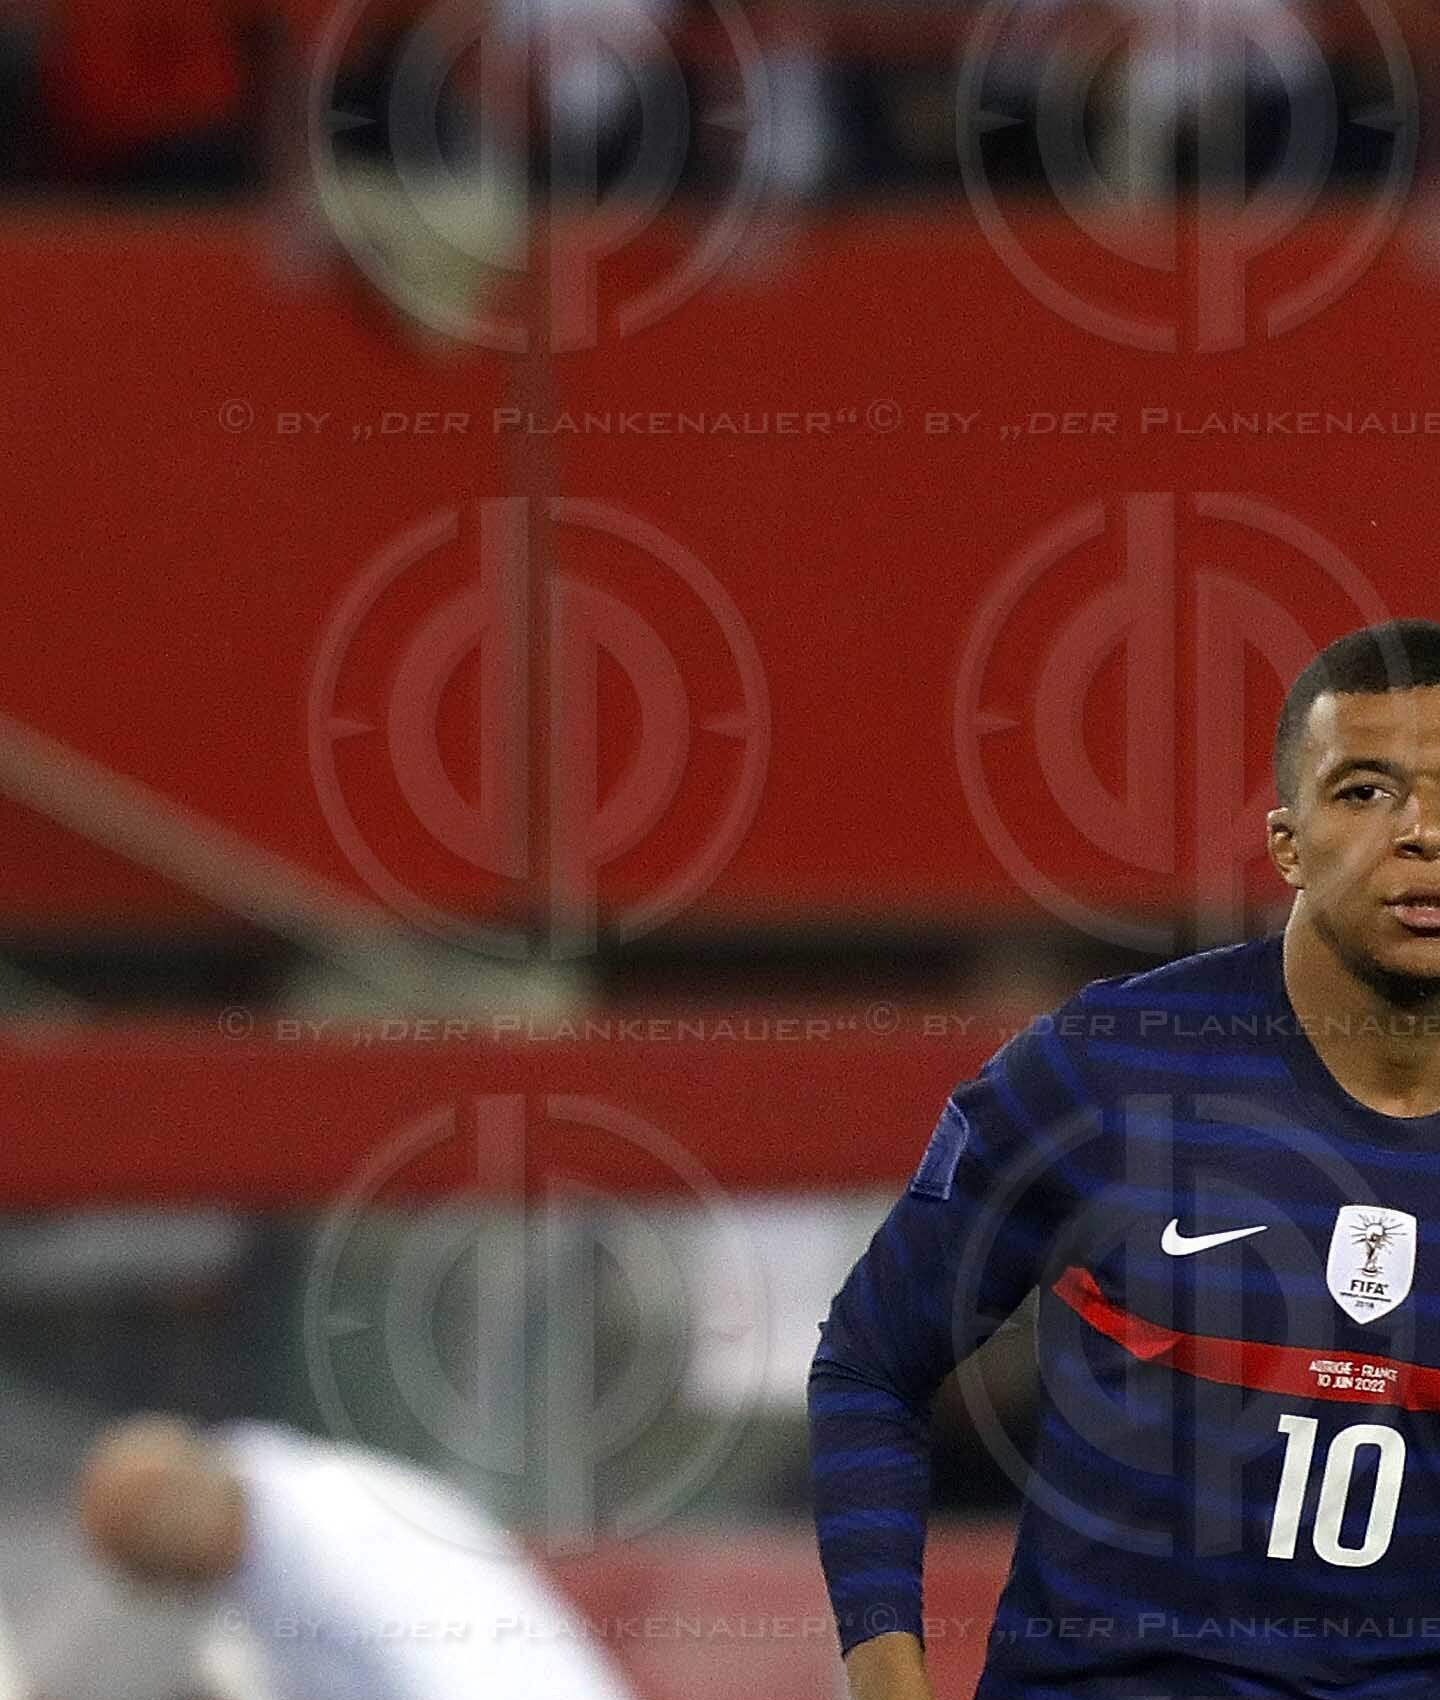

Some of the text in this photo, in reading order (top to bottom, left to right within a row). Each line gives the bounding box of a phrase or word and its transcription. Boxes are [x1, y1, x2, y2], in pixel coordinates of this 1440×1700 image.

[1350, 1279, 1384, 1295] FIFA
[1317, 1373, 1332, 1388] 10
[1354, 1377, 1386, 1393] 2022
[1267, 1414, 1407, 1567] 10
